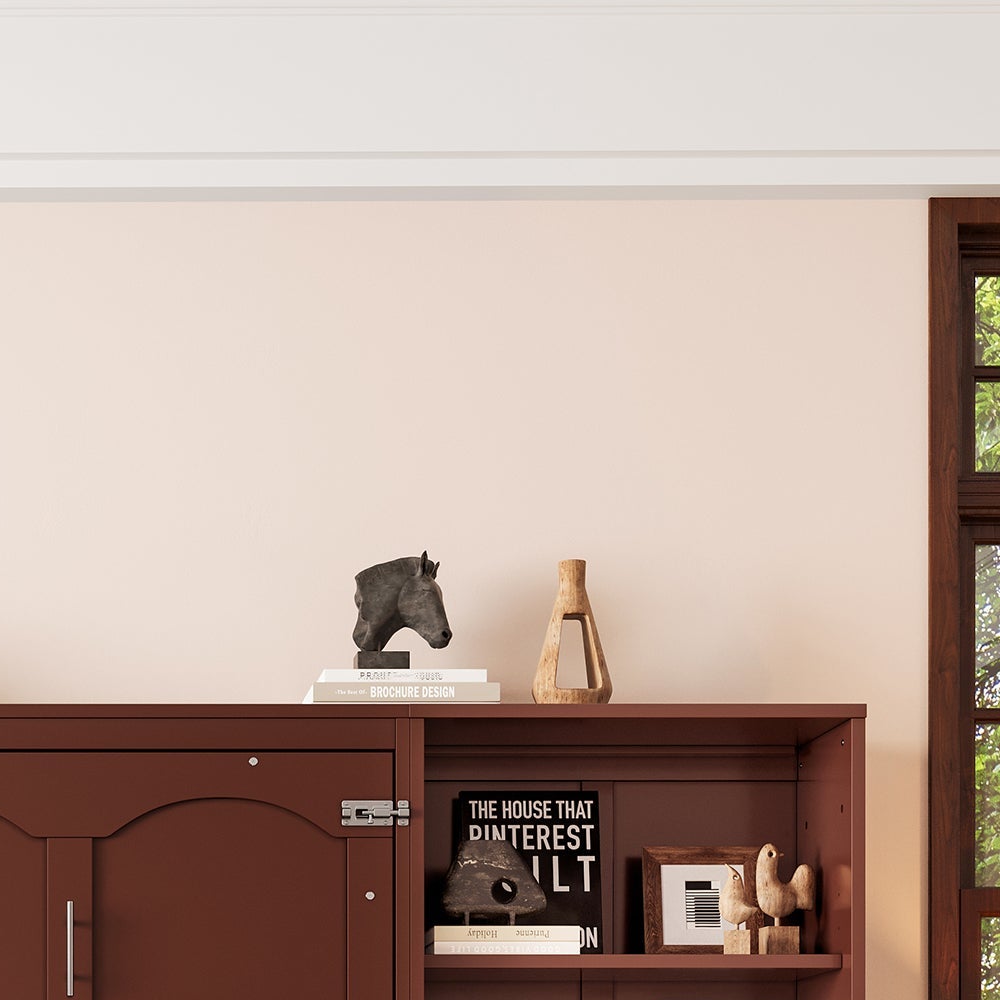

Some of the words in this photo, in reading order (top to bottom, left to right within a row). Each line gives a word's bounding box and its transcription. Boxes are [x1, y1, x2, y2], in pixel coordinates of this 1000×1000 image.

[370, 686, 419, 698] BROCHURE
[422, 686, 455, 698] DESIGN
[468, 800, 498, 819] THE
[502, 800, 552, 819] HOUSE
[555, 800, 594, 819] THAT
[469, 824, 595, 850] PINTEREST
[532, 855, 596, 892] ILT
[467, 928, 498, 939] Holiday
